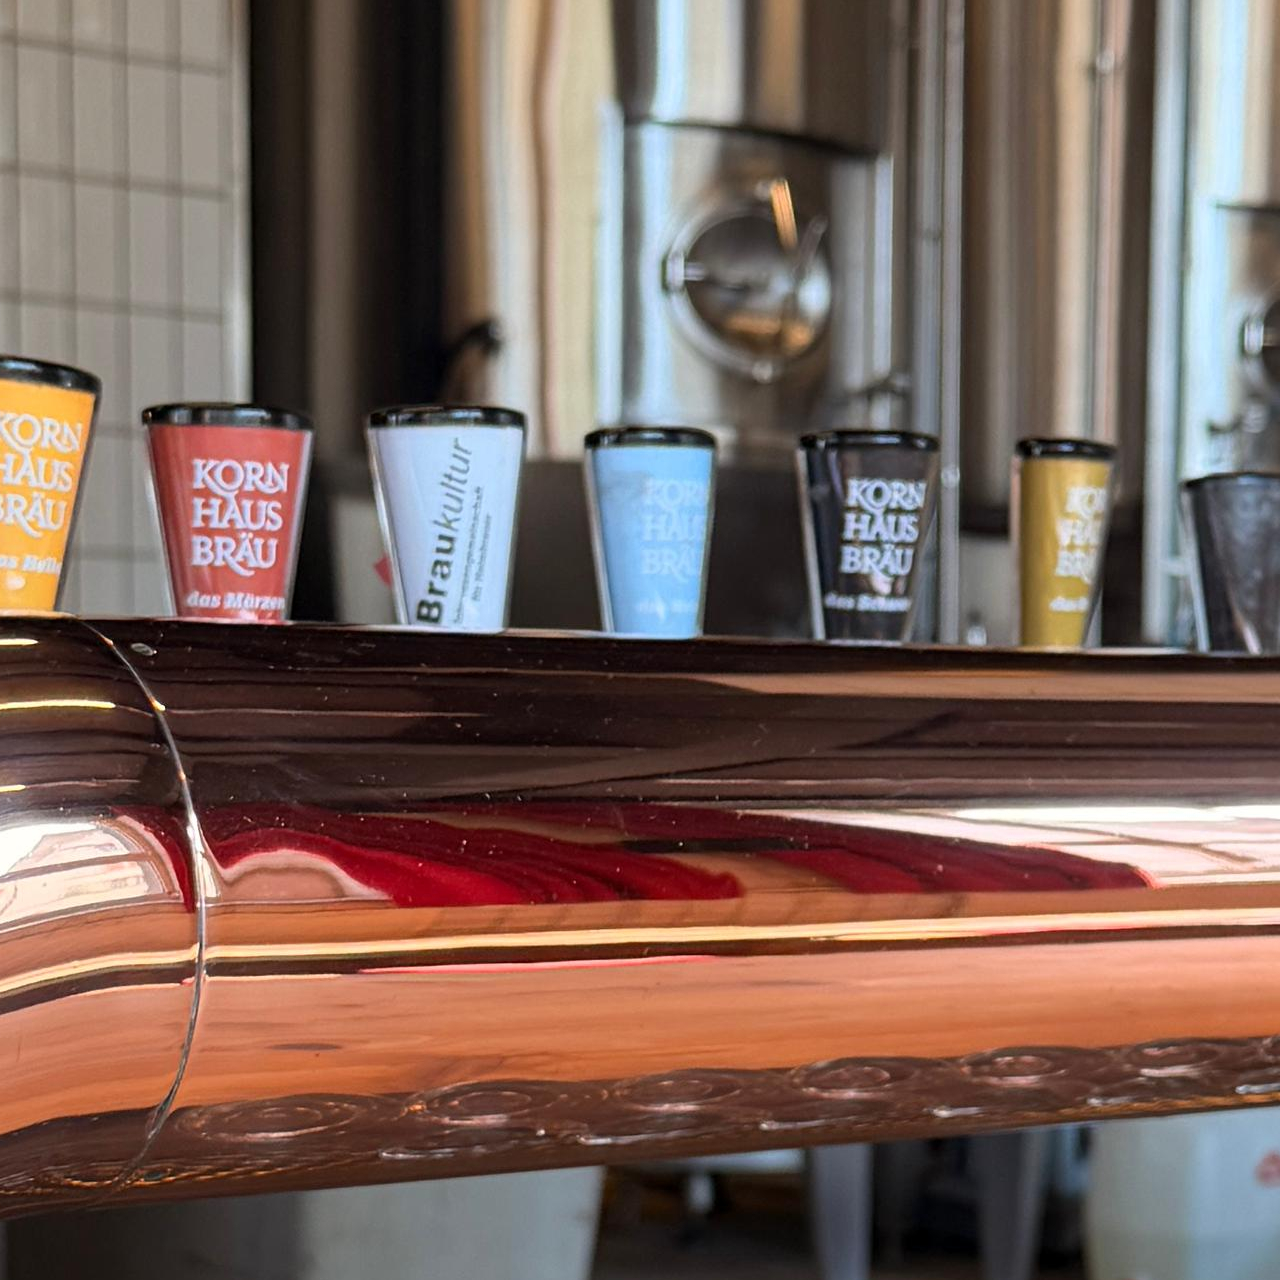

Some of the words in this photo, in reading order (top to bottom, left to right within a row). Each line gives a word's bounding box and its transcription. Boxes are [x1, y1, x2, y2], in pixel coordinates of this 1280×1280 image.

[192, 458, 290, 496] KORN
[644, 477, 705, 511] KOR
[847, 478, 927, 511] KORN
[192, 491, 283, 531] HAUS
[843, 508, 919, 542] HAUS
[416, 437, 472, 624] Braukultur
[191, 532, 278, 577] BRÄU
[840, 543, 914, 581] BRÄU
[187, 591, 221, 609] das
